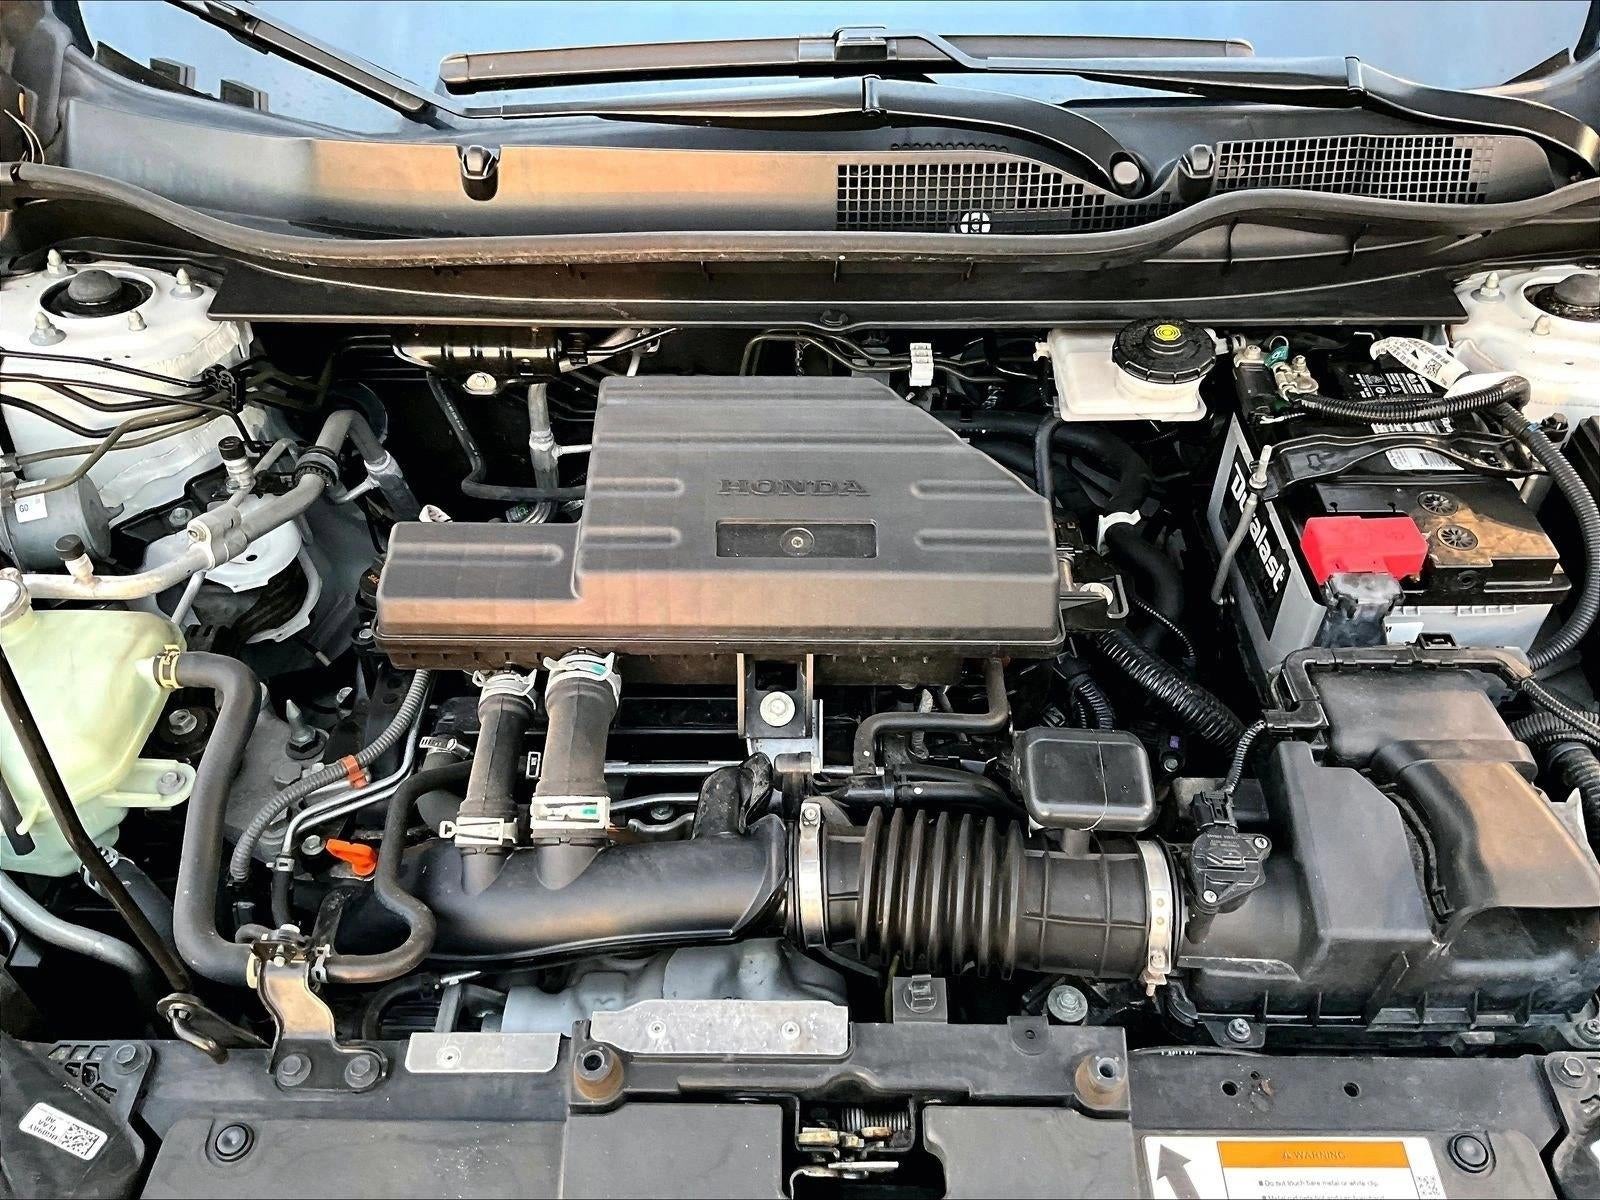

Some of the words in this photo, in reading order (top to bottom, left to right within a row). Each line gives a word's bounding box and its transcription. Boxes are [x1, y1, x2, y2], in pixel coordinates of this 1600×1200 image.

[717, 479, 871, 497] HONDA
[1231, 461, 1285, 593] Dualast
[1293, 1151, 1346, 1160] WARNING
